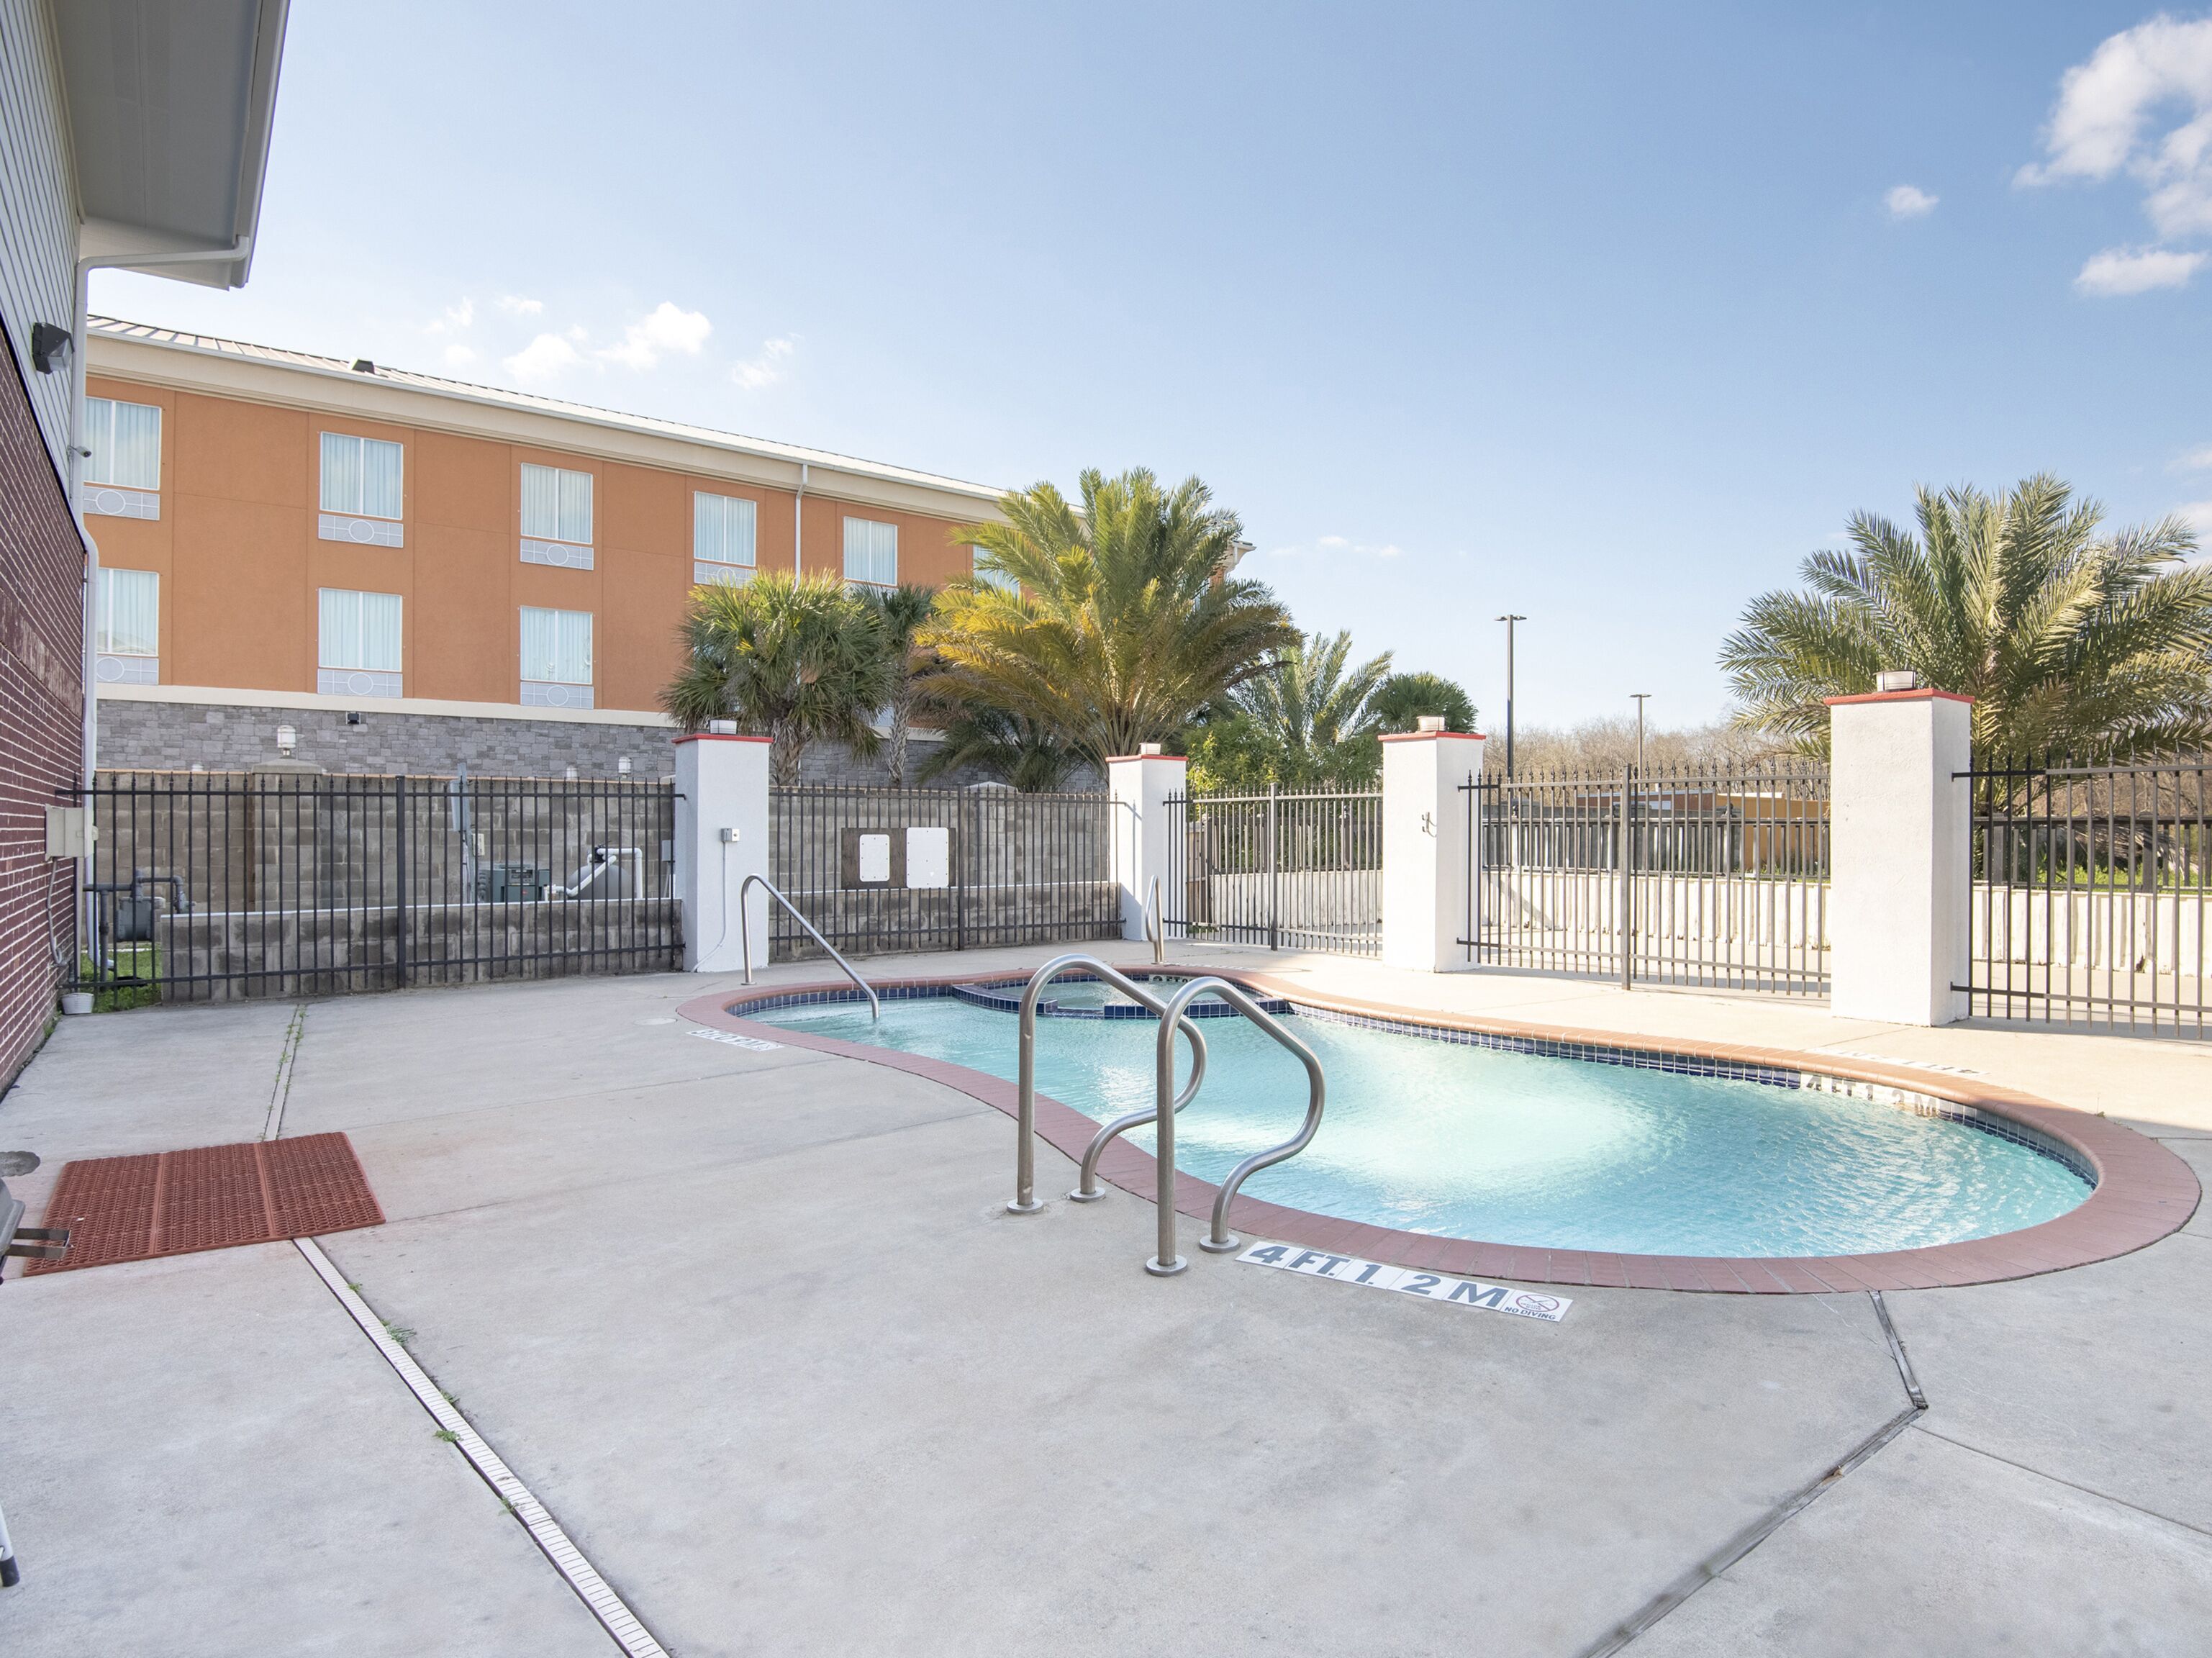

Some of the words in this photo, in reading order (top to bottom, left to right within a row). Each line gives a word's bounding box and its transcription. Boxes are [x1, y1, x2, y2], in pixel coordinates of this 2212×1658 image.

[1806, 1075, 1822, 1091] 4
[1248, 1246, 1289, 1264] 4
[1446, 1282, 1510, 1308] M
[1520, 1310, 1556, 1320] DIVING
